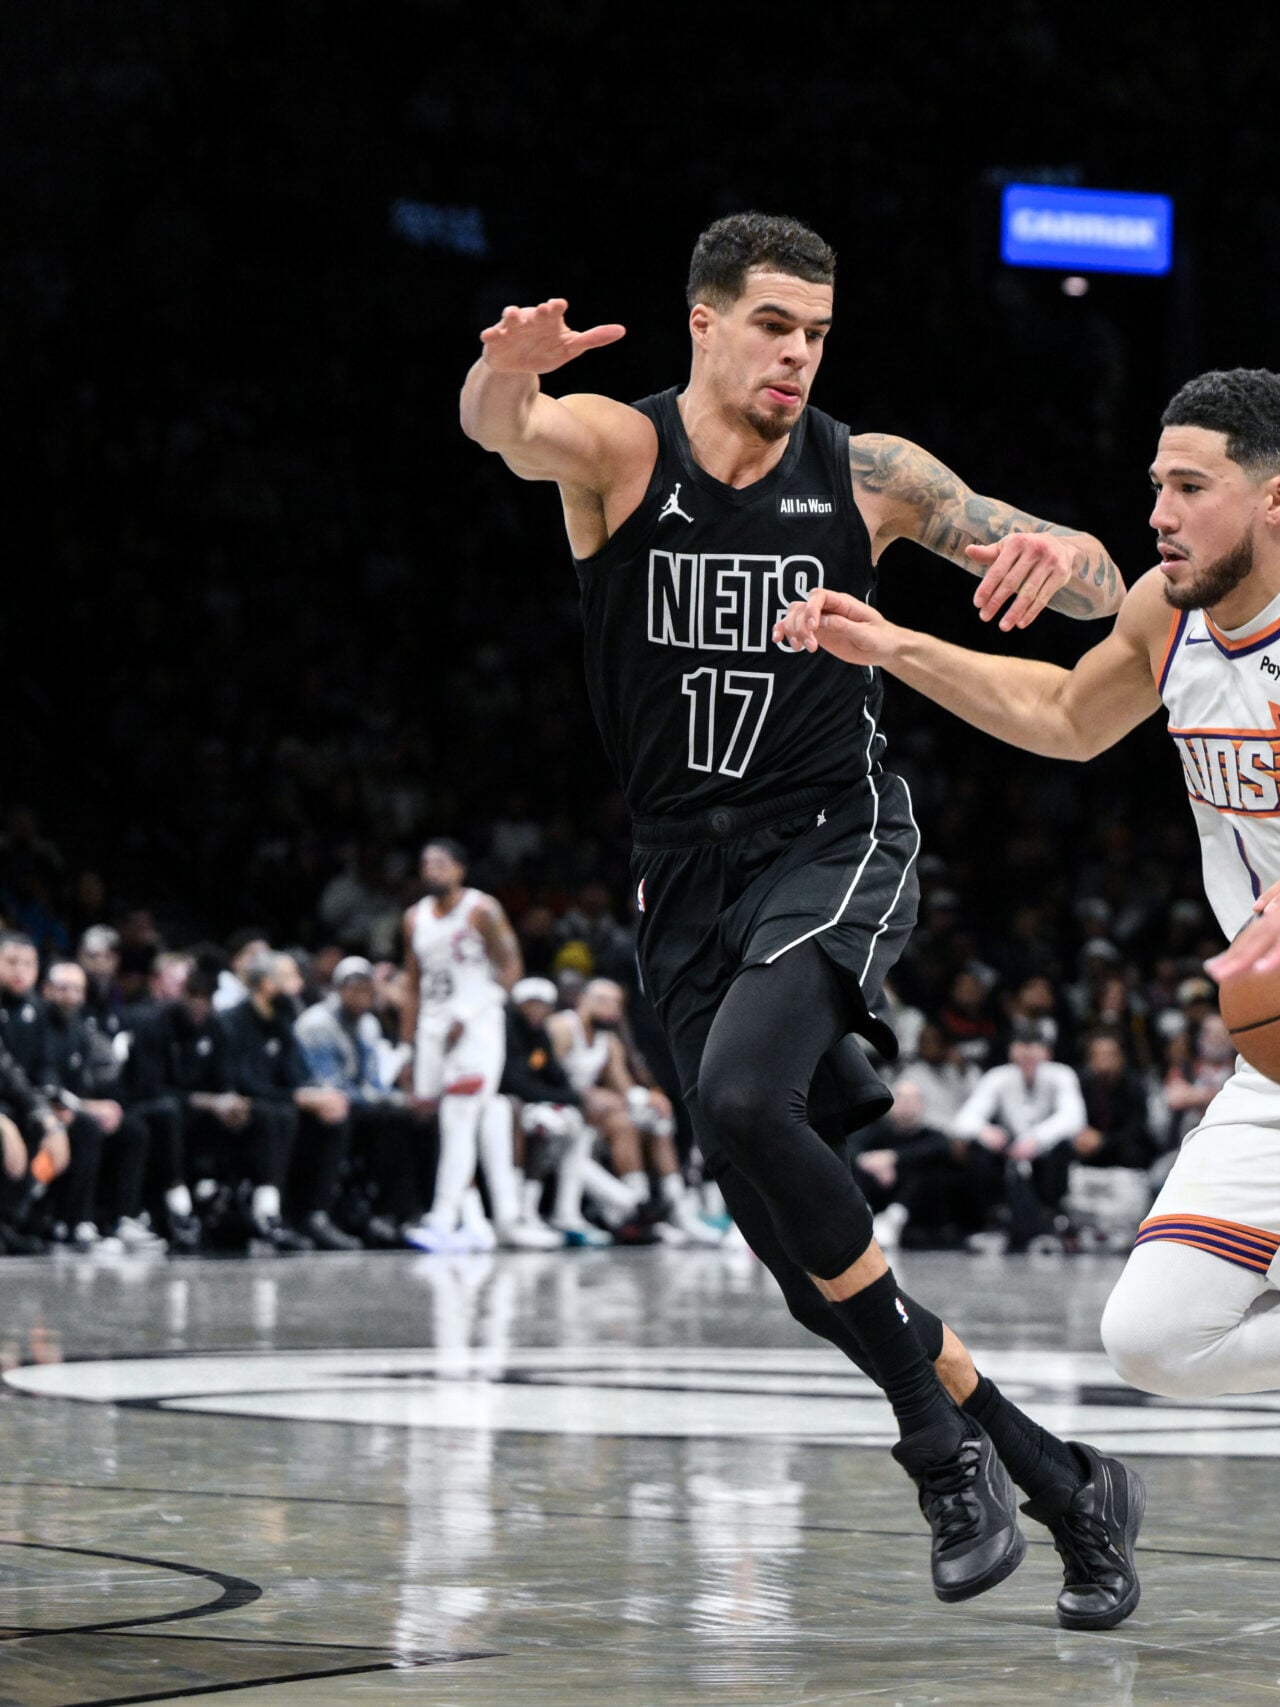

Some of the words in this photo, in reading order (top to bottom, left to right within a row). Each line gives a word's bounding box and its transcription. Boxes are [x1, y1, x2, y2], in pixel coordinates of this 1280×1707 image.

[780, 498, 794, 513] All
[796, 498, 807, 513] In
[807, 498, 832, 513] Won
[648, 549, 824, 653] NETS
[682, 666, 775, 779] 17
[1174, 738, 1280, 811] UNS
